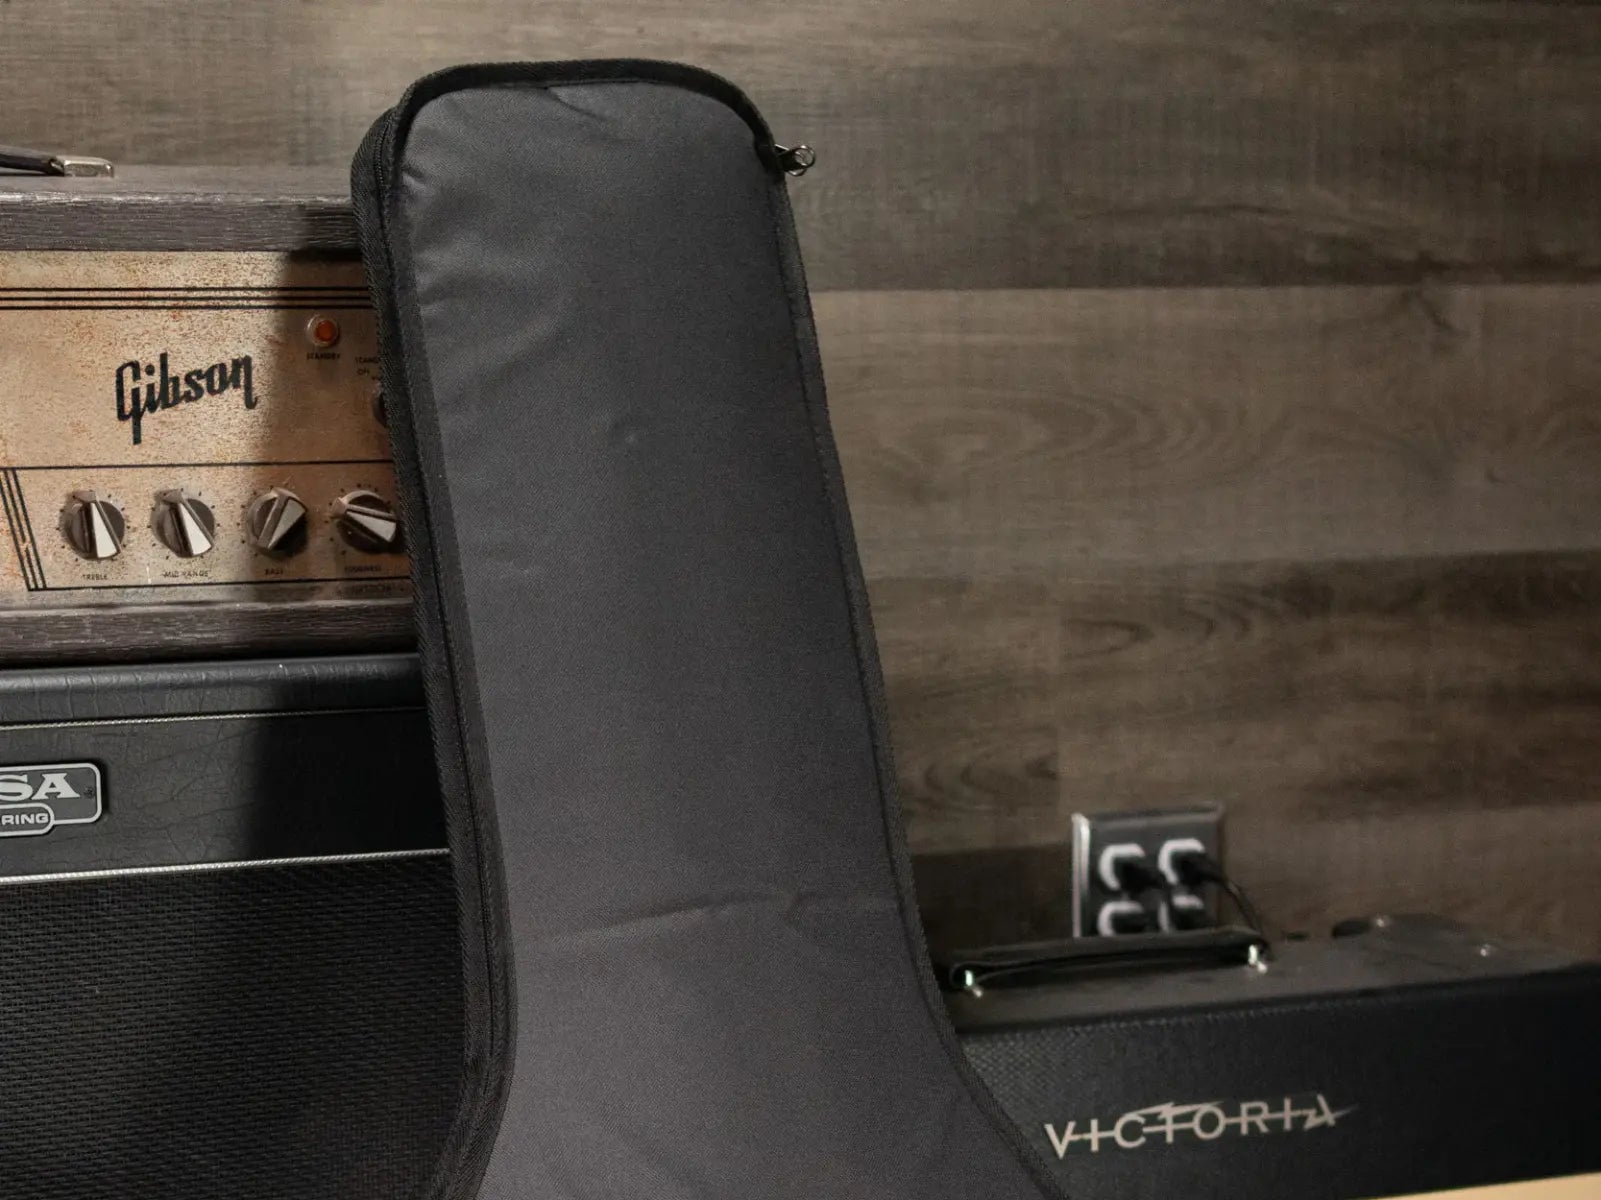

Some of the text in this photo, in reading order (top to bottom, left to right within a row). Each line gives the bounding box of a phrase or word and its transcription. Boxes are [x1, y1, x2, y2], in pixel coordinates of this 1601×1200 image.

[115, 353, 258, 445] Gibson
[1, 812, 49, 826] RING
[1044, 1094, 1337, 1160] VICTORIA
